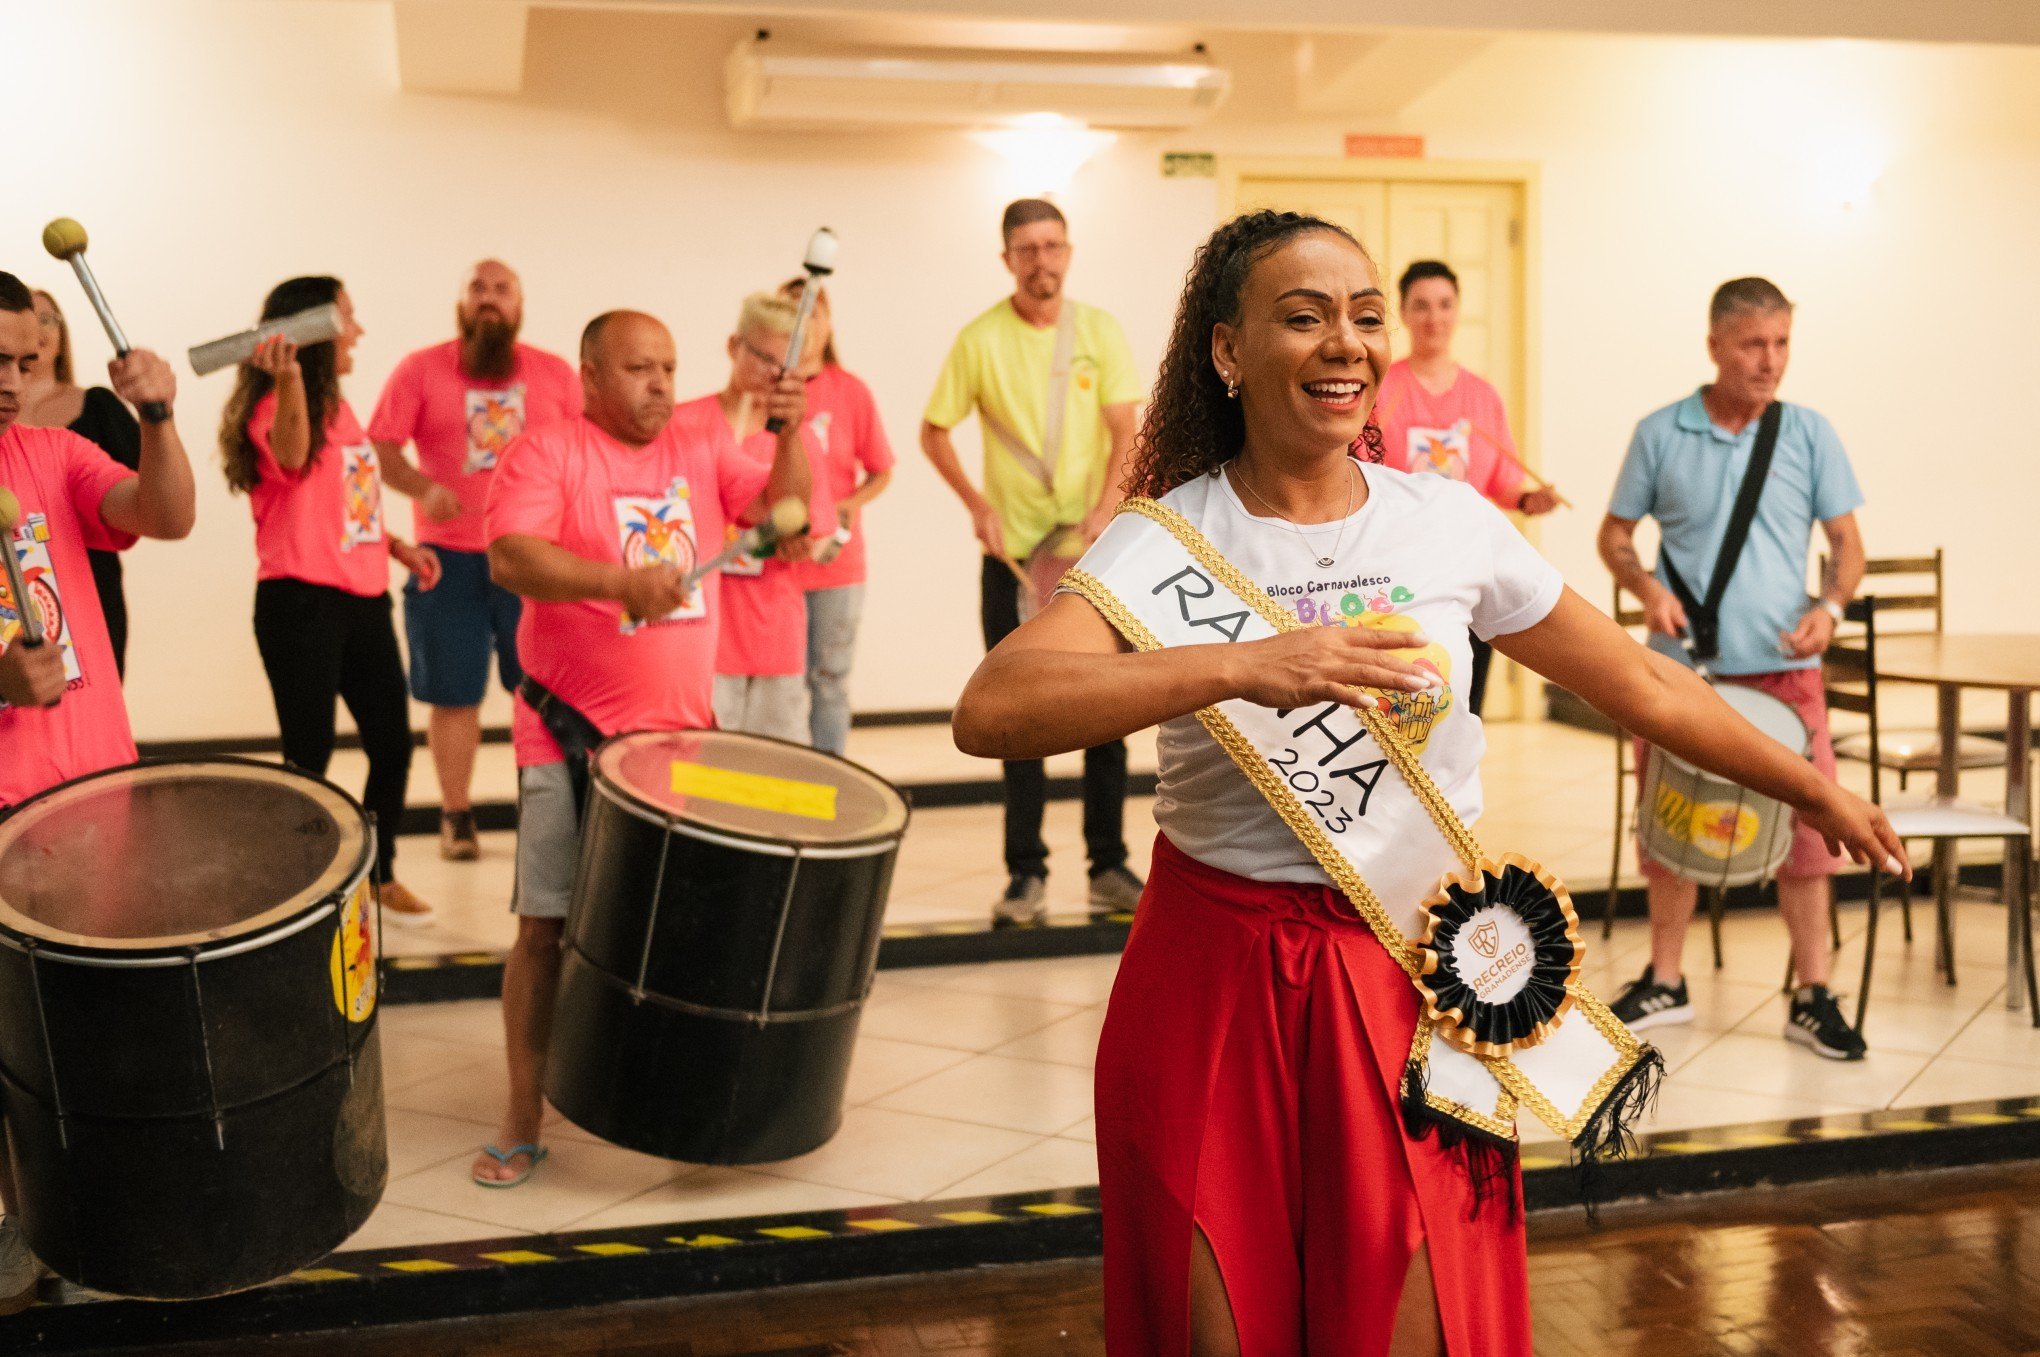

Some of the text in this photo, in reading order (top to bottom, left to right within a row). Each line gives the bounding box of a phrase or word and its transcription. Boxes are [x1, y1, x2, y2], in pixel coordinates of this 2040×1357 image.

[1267, 575, 1391, 598] Bloco Carnavalesco
[1152, 565, 1389, 816] RAHA
[1268, 748, 1354, 834] 2023
[1472, 942, 1526, 991] RECREIO
[1479, 953, 1532, 999] GRAMADENSE
